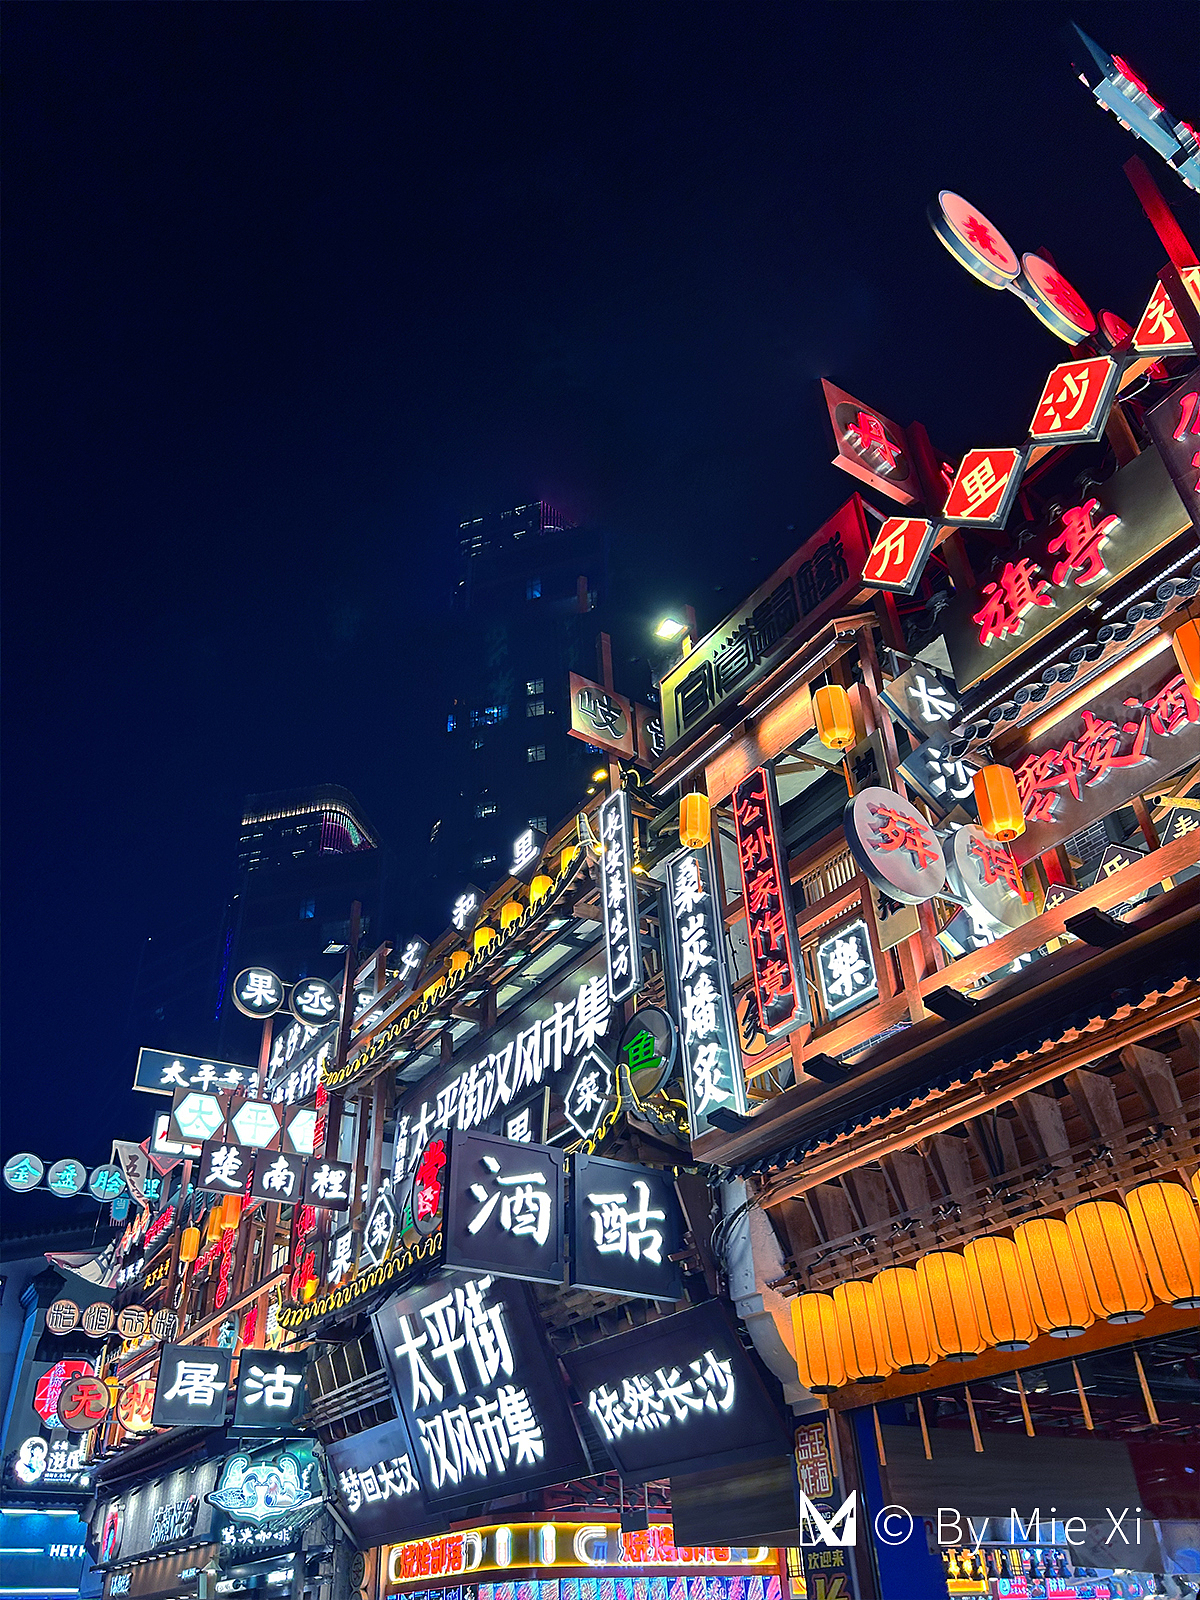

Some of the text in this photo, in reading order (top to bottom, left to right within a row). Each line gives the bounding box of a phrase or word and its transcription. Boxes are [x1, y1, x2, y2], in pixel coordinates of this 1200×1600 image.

[972, 497, 1122, 647] 旗亭
[408, 972, 611, 1175] 太平街汉风市集
[467, 1155, 667, 1266] 酒酤
[163, 1359, 303, 1407] 屠沽
[395, 1273, 514, 1412] 太平街
[588, 1348, 738, 1442] 依然长沙
[340, 1451, 421, 1513] 梦回大汉
[416, 1384, 546, 1490] 汉风市集
